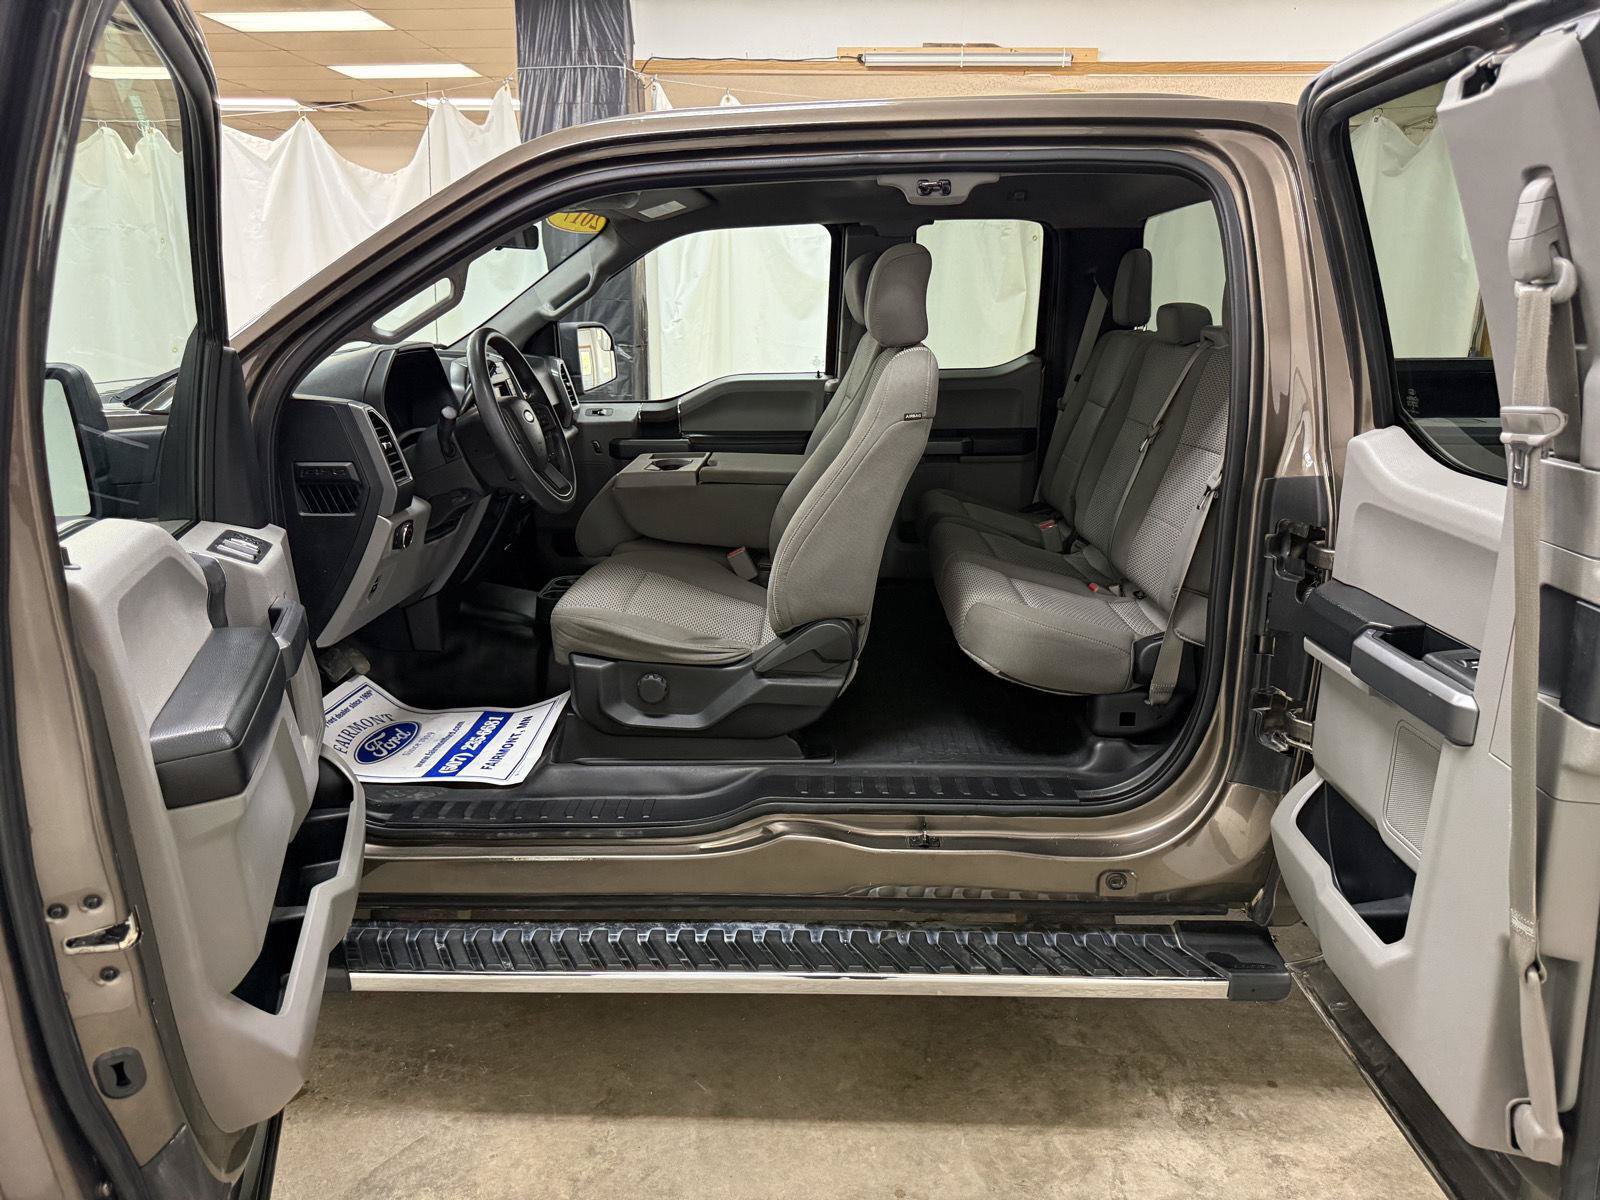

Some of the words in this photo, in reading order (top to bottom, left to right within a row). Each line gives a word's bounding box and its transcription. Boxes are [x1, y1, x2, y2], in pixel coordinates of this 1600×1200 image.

[349, 697, 363, 709] since
[333, 713, 395, 755] FAIRMONT
[364, 728, 411, 758] Ford
[438, 752, 474, 774] (507)
[460, 716, 504, 751] 235-6681
[480, 729, 524, 771] FAIRMONT,
[517, 714, 533, 729] MN
